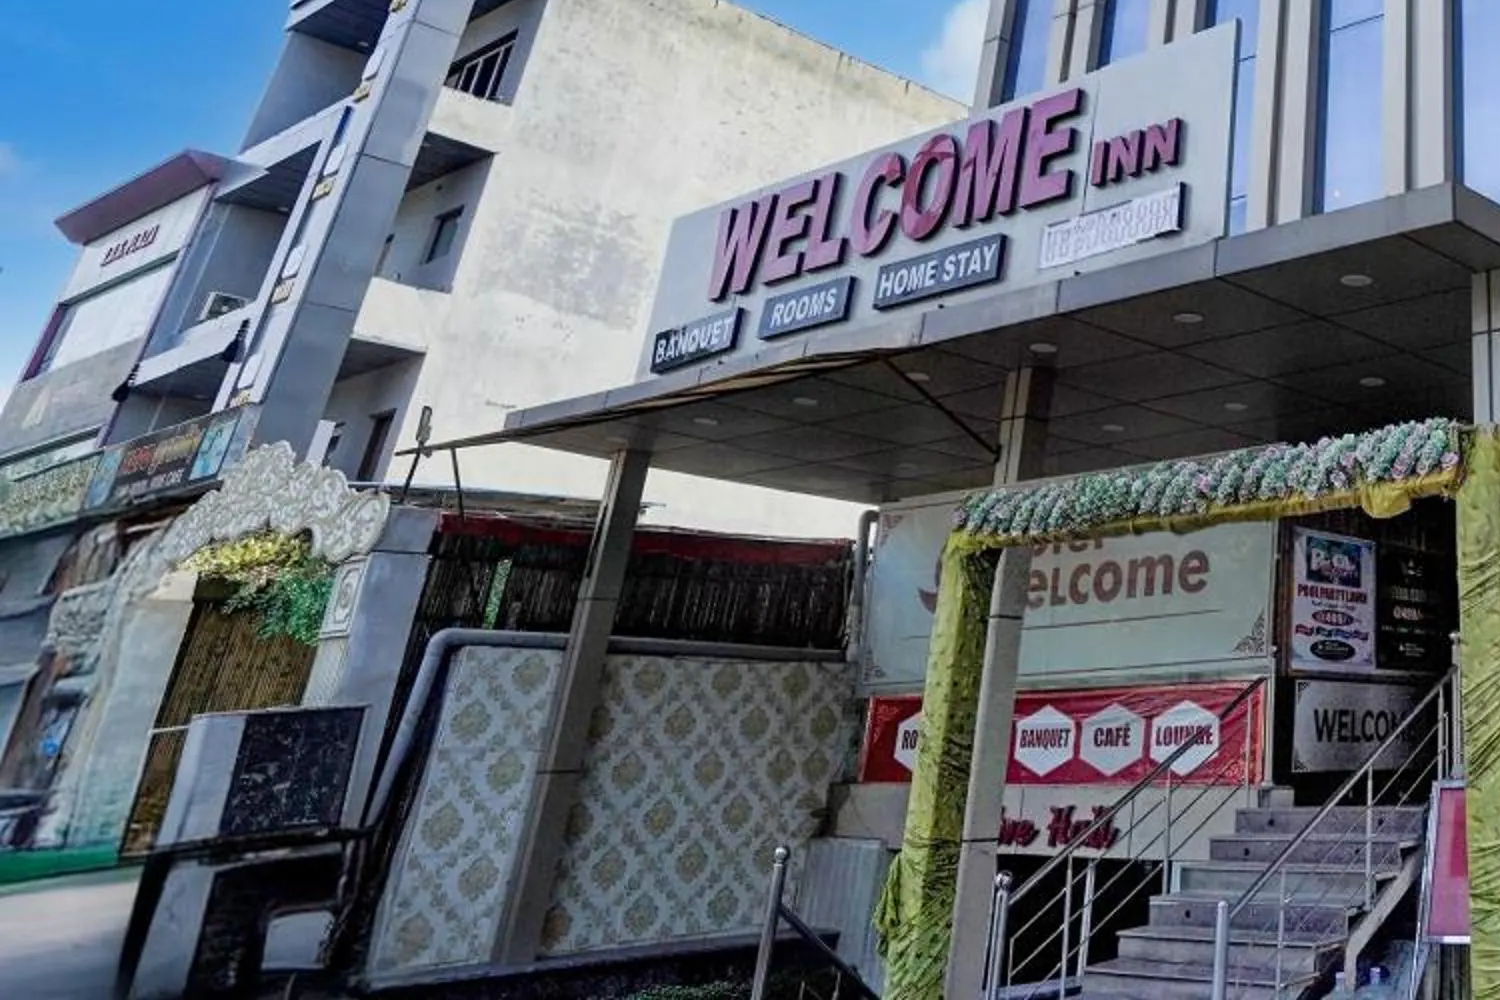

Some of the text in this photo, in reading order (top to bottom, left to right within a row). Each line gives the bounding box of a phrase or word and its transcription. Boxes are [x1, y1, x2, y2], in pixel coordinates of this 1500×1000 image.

[709, 87, 1084, 302] WELCOME
[1091, 118, 1183, 186] INN
[877, 243, 998, 300] HOME STAY
[769, 288, 838, 329] ROOMS
[655, 317, 736, 365] BANQUET
[1019, 728, 1072, 750] BANQUET
[1093, 722, 1131, 747] CAFÉ
